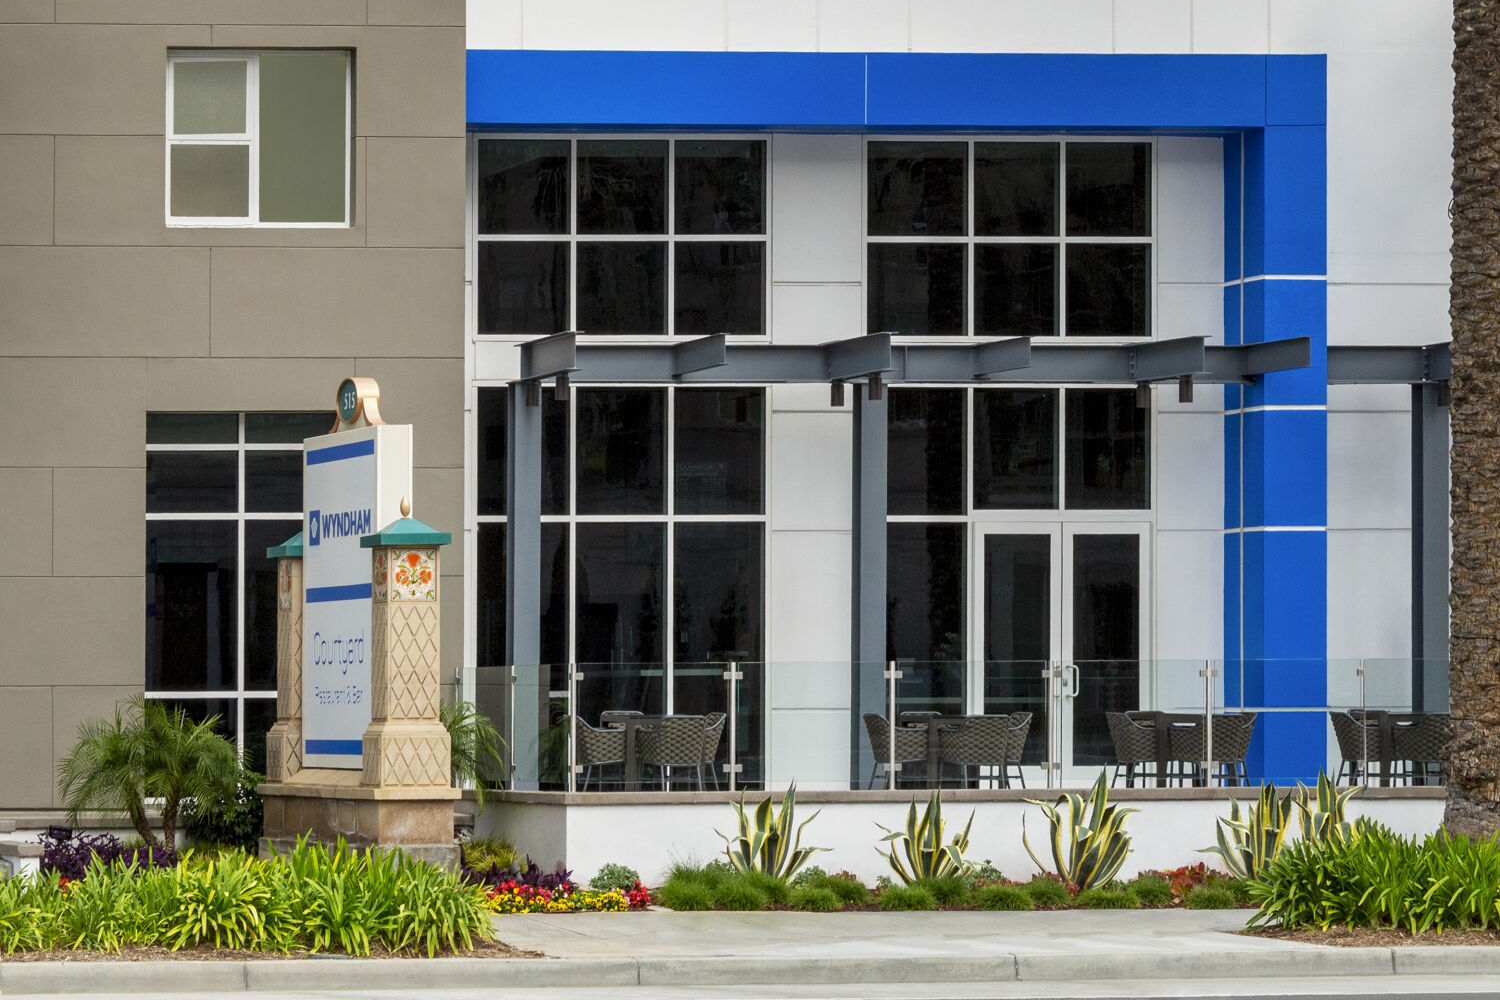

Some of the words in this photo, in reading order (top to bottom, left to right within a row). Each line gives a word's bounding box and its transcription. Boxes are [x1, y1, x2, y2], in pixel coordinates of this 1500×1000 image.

[344, 391, 356, 410] 515
[321, 508, 371, 540] WYNDHAM
[313, 630, 364, 675] Courtyard
